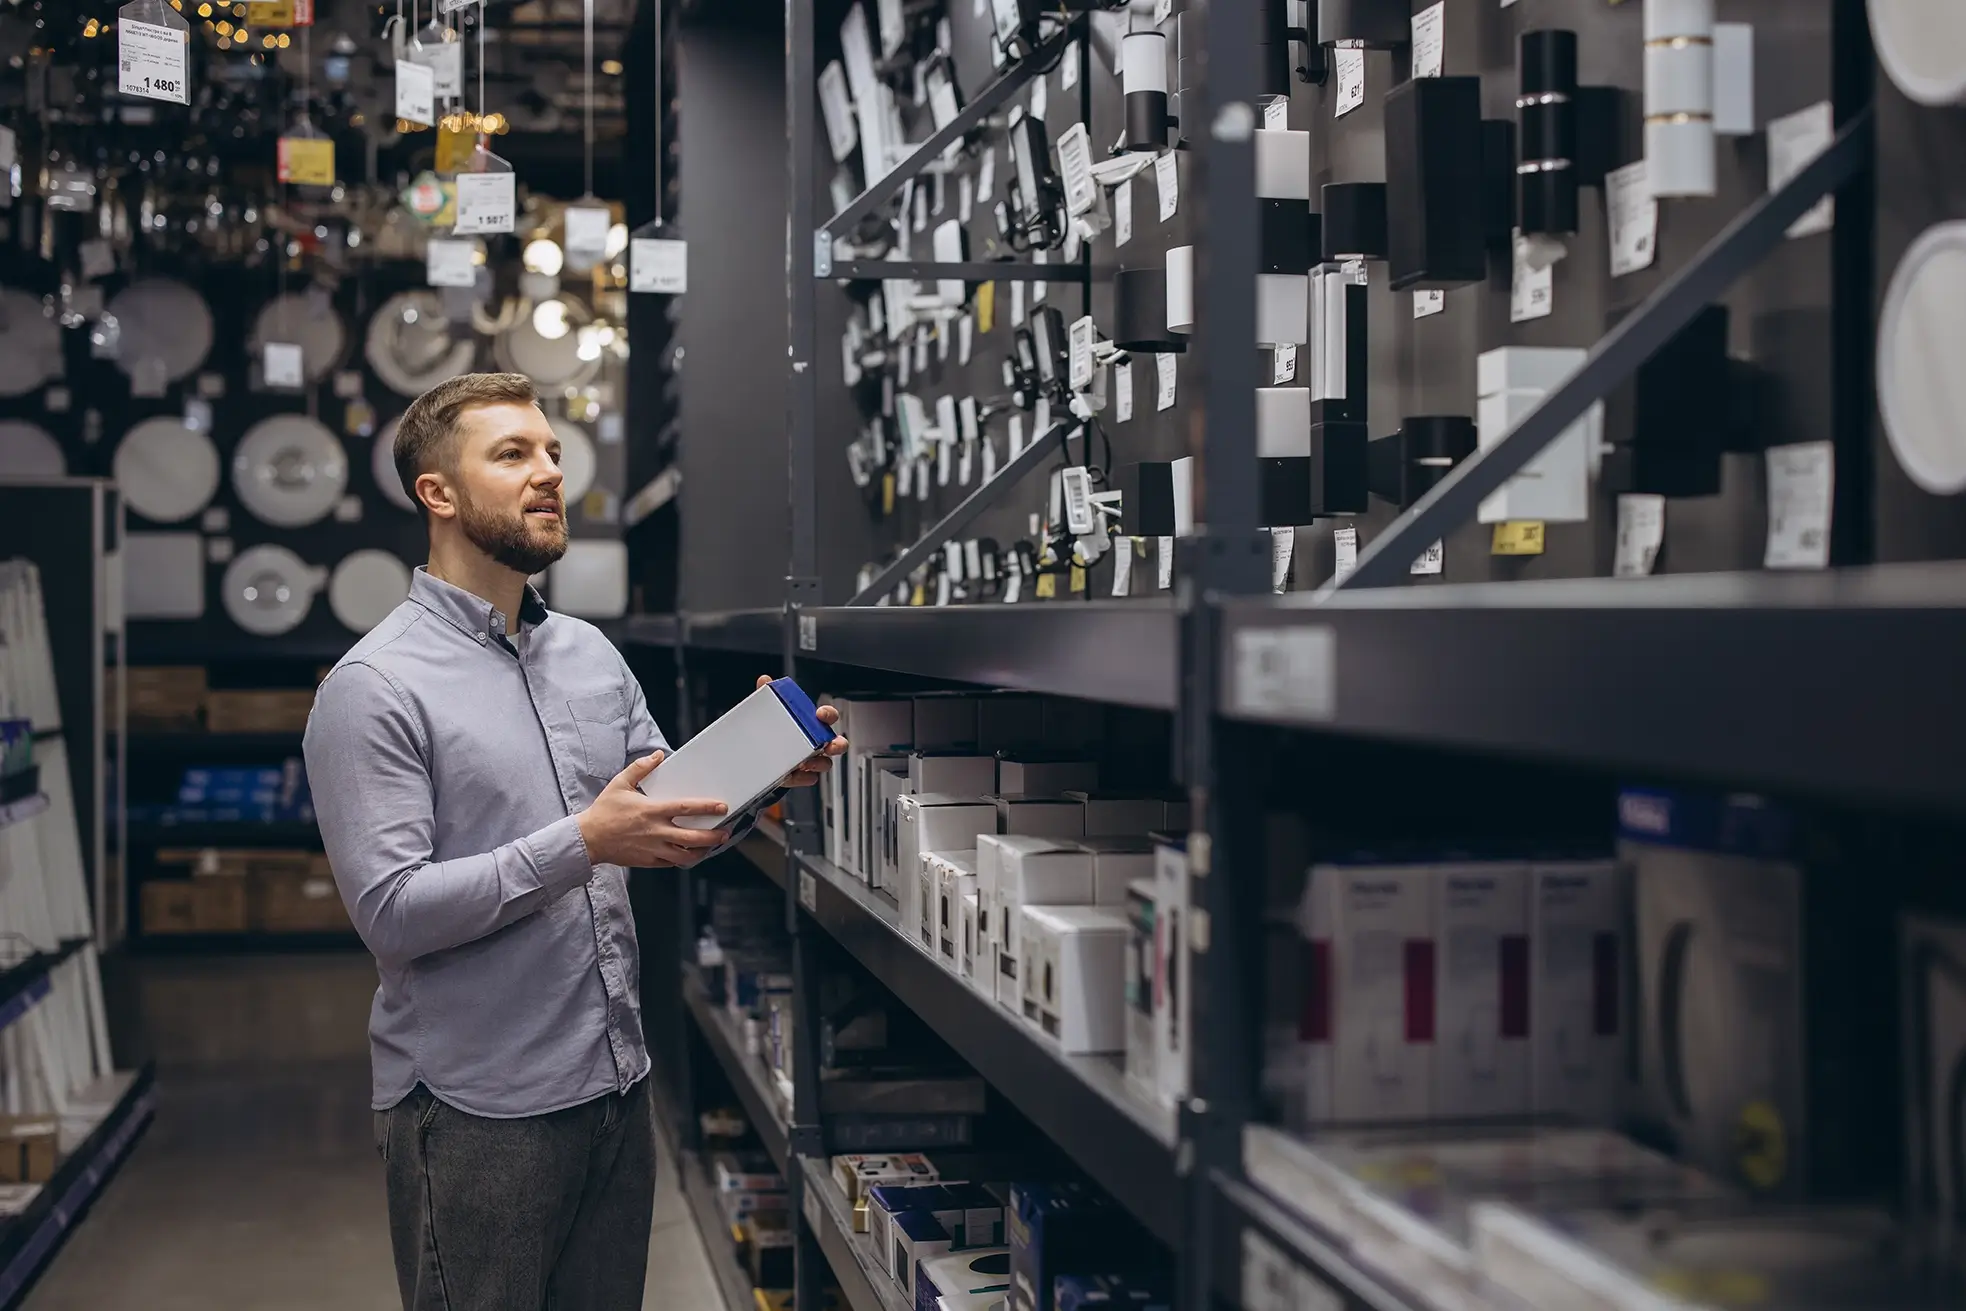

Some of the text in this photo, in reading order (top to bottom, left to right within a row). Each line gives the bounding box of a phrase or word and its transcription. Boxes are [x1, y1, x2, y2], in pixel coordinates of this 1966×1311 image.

[126, 84, 150, 94] 1078314
[144, 77, 150, 88] 1
[153, 79, 175, 92] 480
